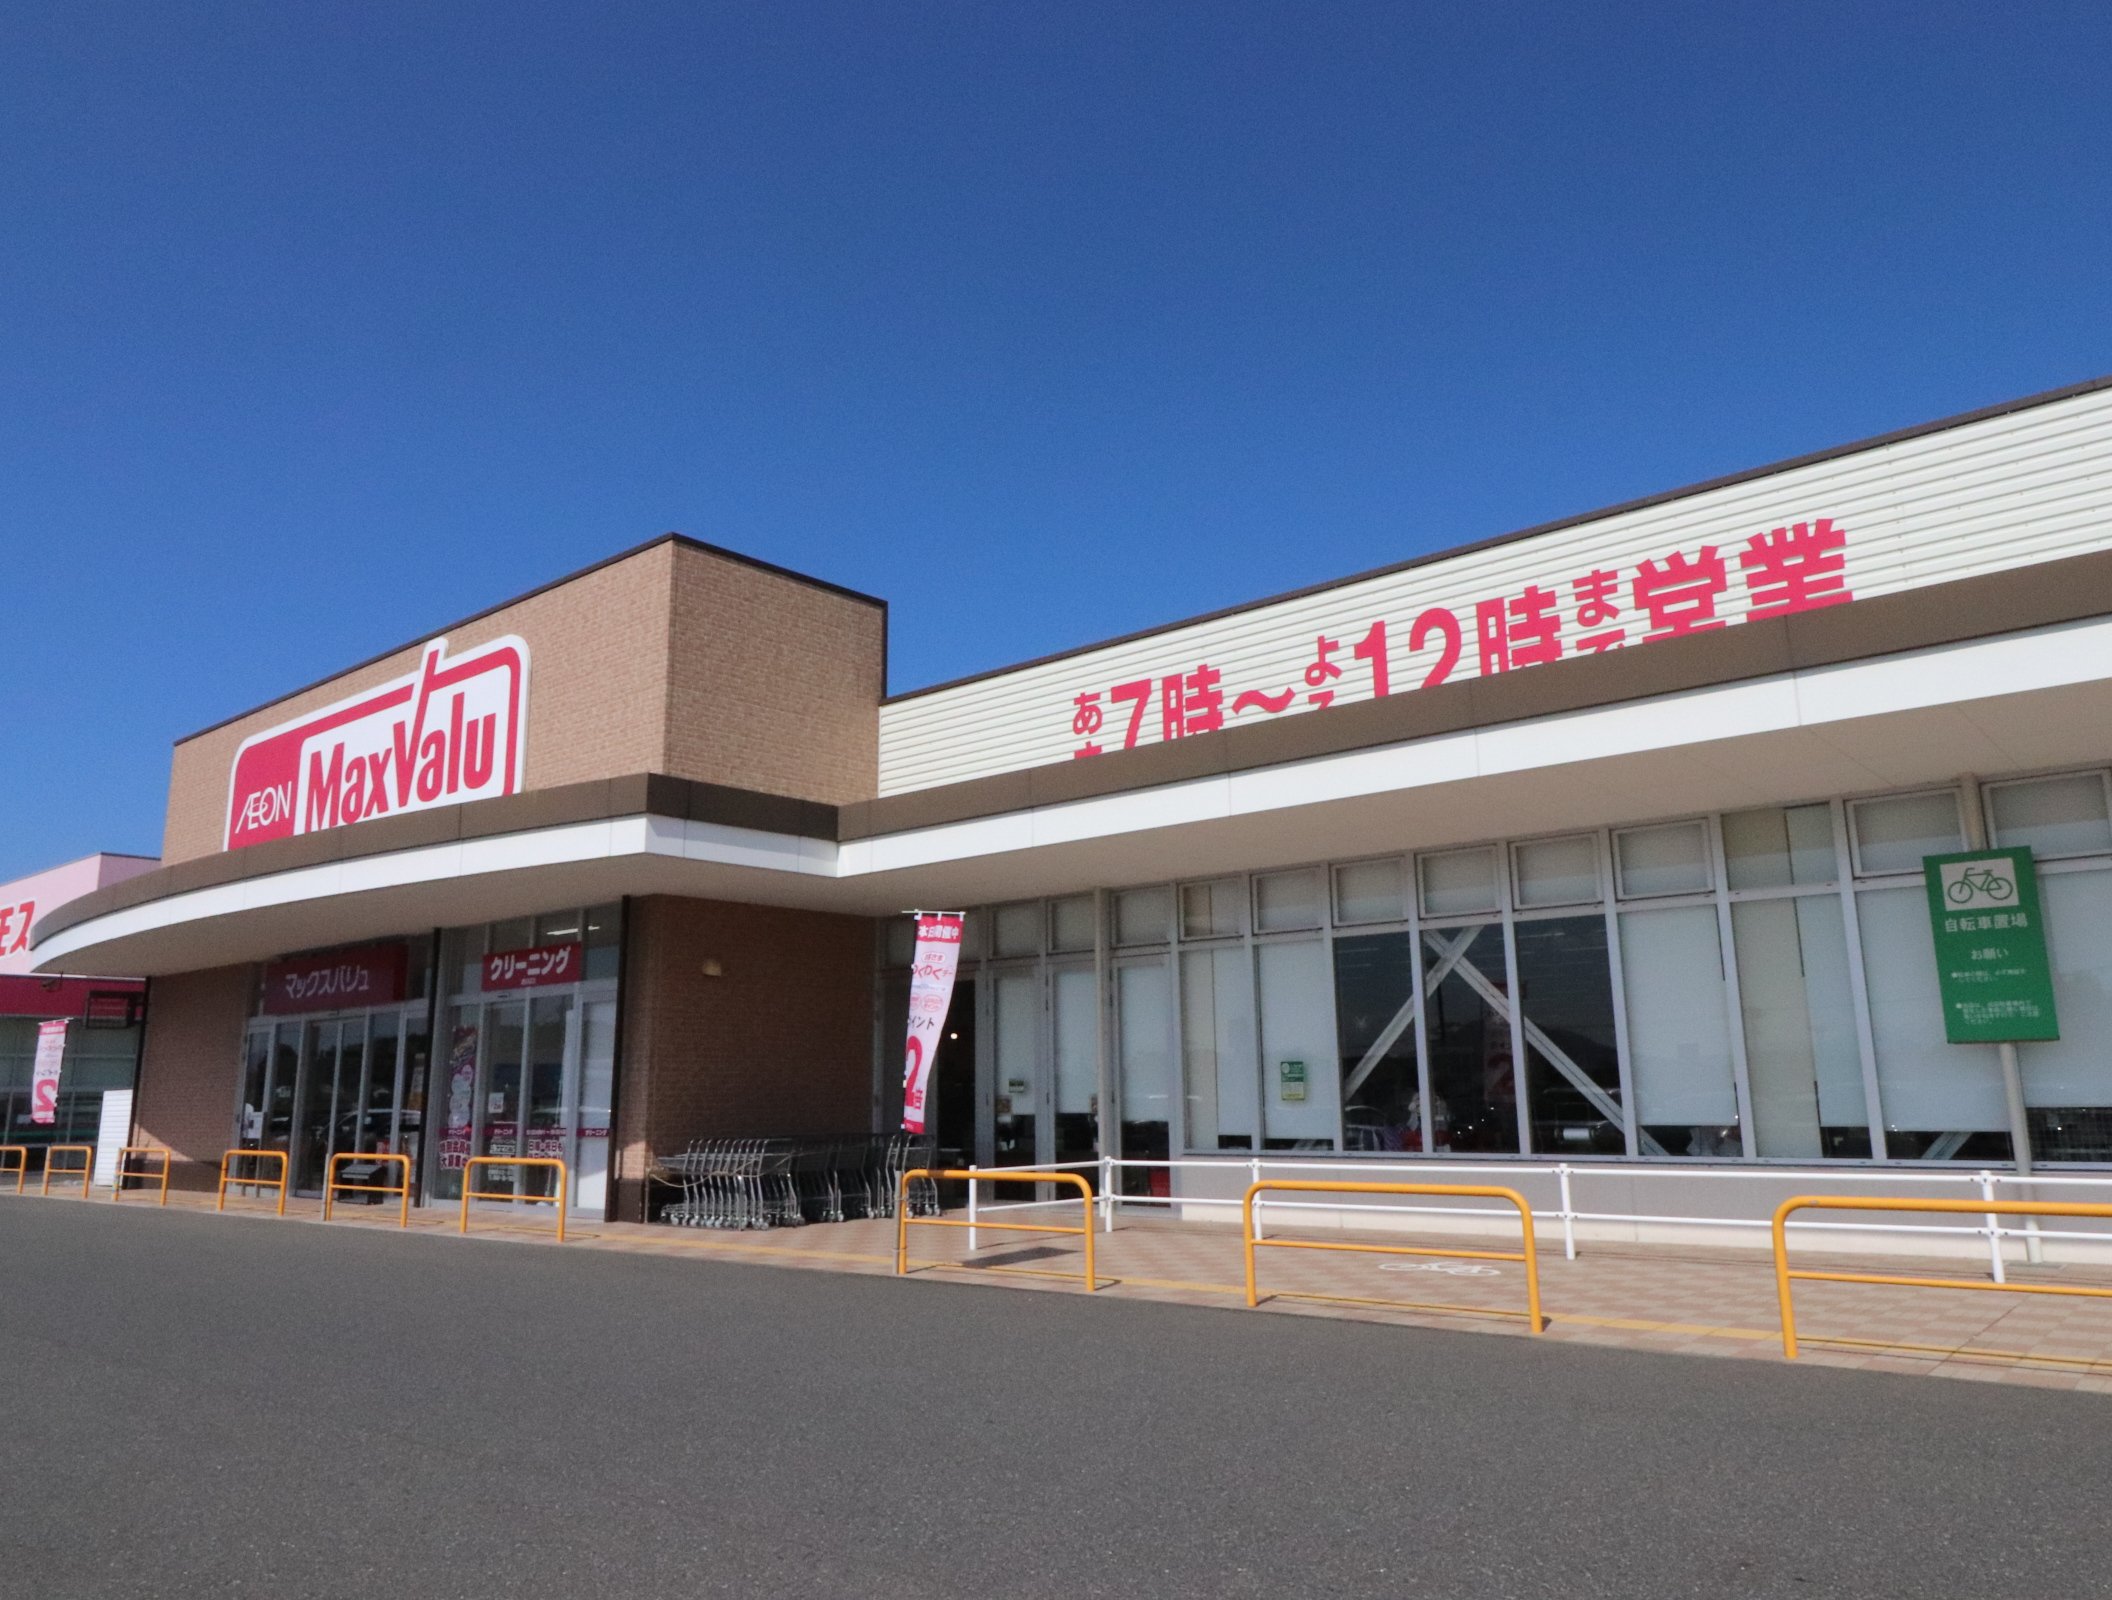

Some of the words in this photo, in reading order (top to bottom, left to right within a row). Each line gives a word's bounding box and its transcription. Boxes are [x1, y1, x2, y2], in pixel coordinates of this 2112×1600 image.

[306, 649, 496, 833] MaxValu
[1944, 912, 2028, 933] 自転車置場
[490, 946, 571, 982] クリーニング
[1971, 946, 2009, 961] お願い
[285, 965, 369, 999] マックスバリュ
